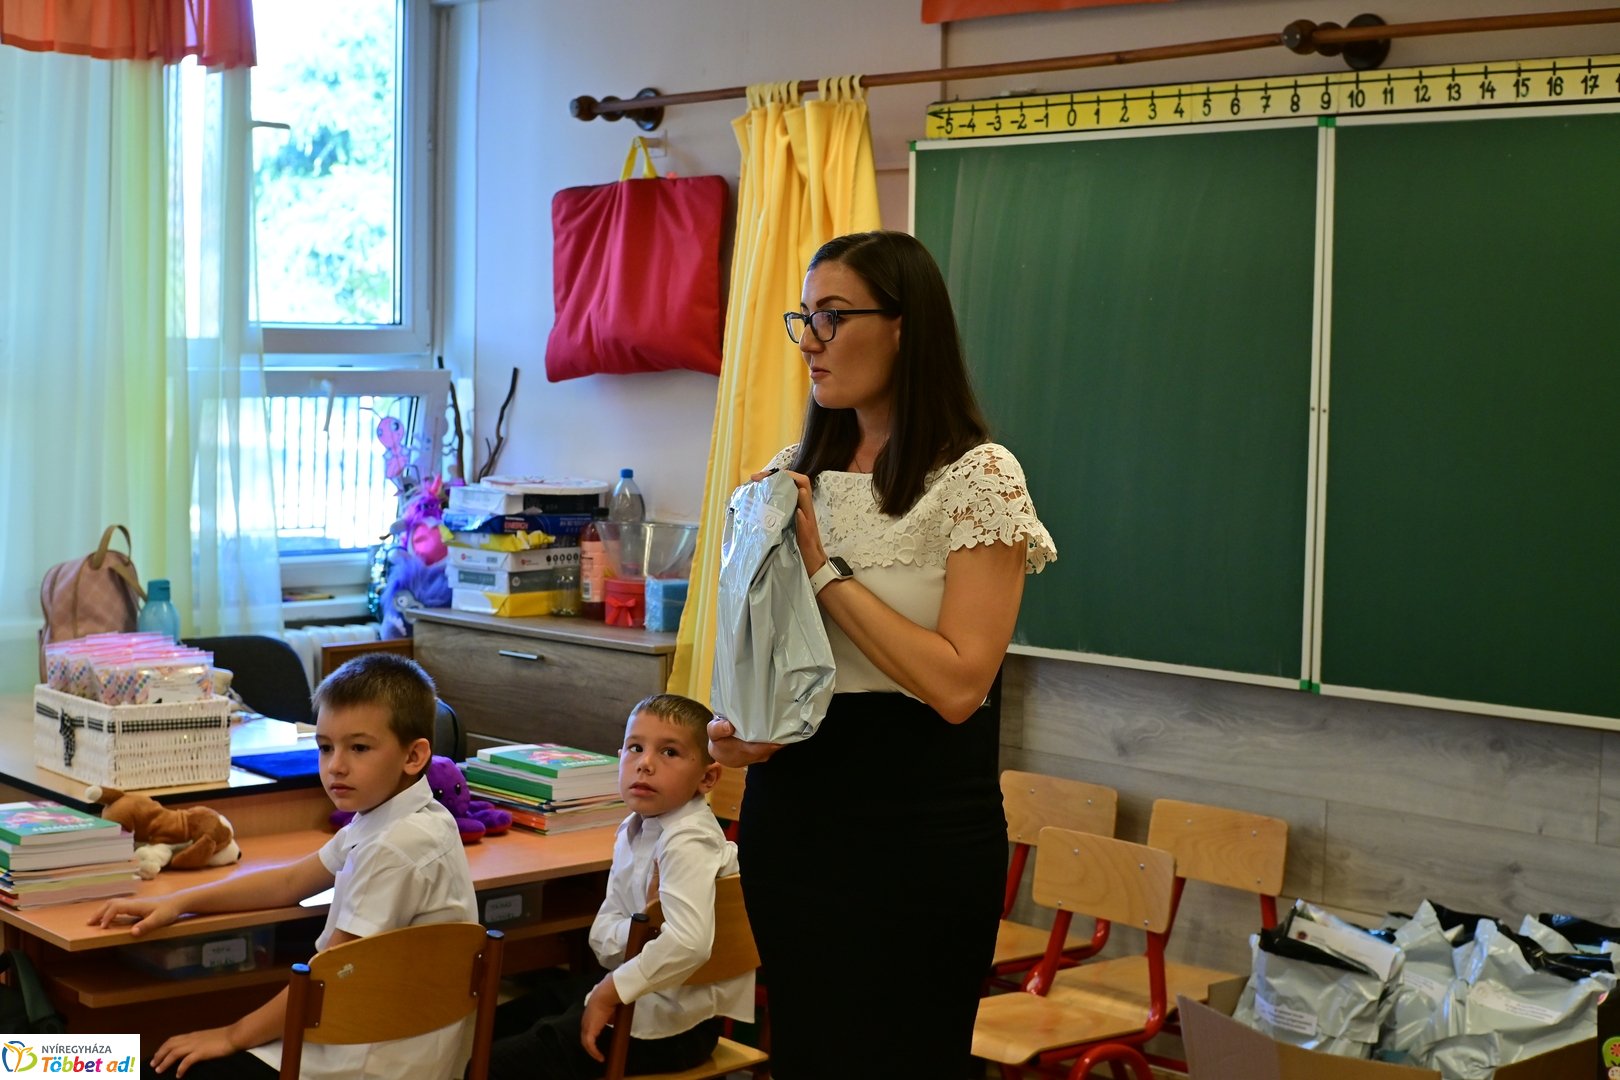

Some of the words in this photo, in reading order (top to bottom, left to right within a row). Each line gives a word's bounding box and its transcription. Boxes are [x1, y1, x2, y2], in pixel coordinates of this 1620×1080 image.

[936, 117, 953, 134] -5
[958, 116, 976, 132] -4
[986, 115, 1002, 131] -3
[1010, 113, 1027, 130] -2
[1034, 112, 1049, 128] -1
[1067, 108, 1077, 127] 0
[1094, 107, 1100, 125] 1
[1119, 105, 1130, 122] 2
[1148, 102, 1157, 120] 3
[1173, 102, 1185, 118] 4
[1202, 98, 1212, 117] 5
[1230, 97, 1241, 116] 6
[1260, 94, 1271, 114] 7
[1290, 93, 1300, 113] 8
[1320, 91, 1332, 110] 9
[1347, 89, 1366, 108] 10
[1382, 86, 1394, 105] 11
[1414, 84, 1431, 103] 12
[1446, 82, 1461, 102] 13
[1479, 80, 1497, 100] 14
[1513, 77, 1531, 98] 15
[1546, 76, 1564, 97] 16
[1580, 73, 1600, 95] 17
